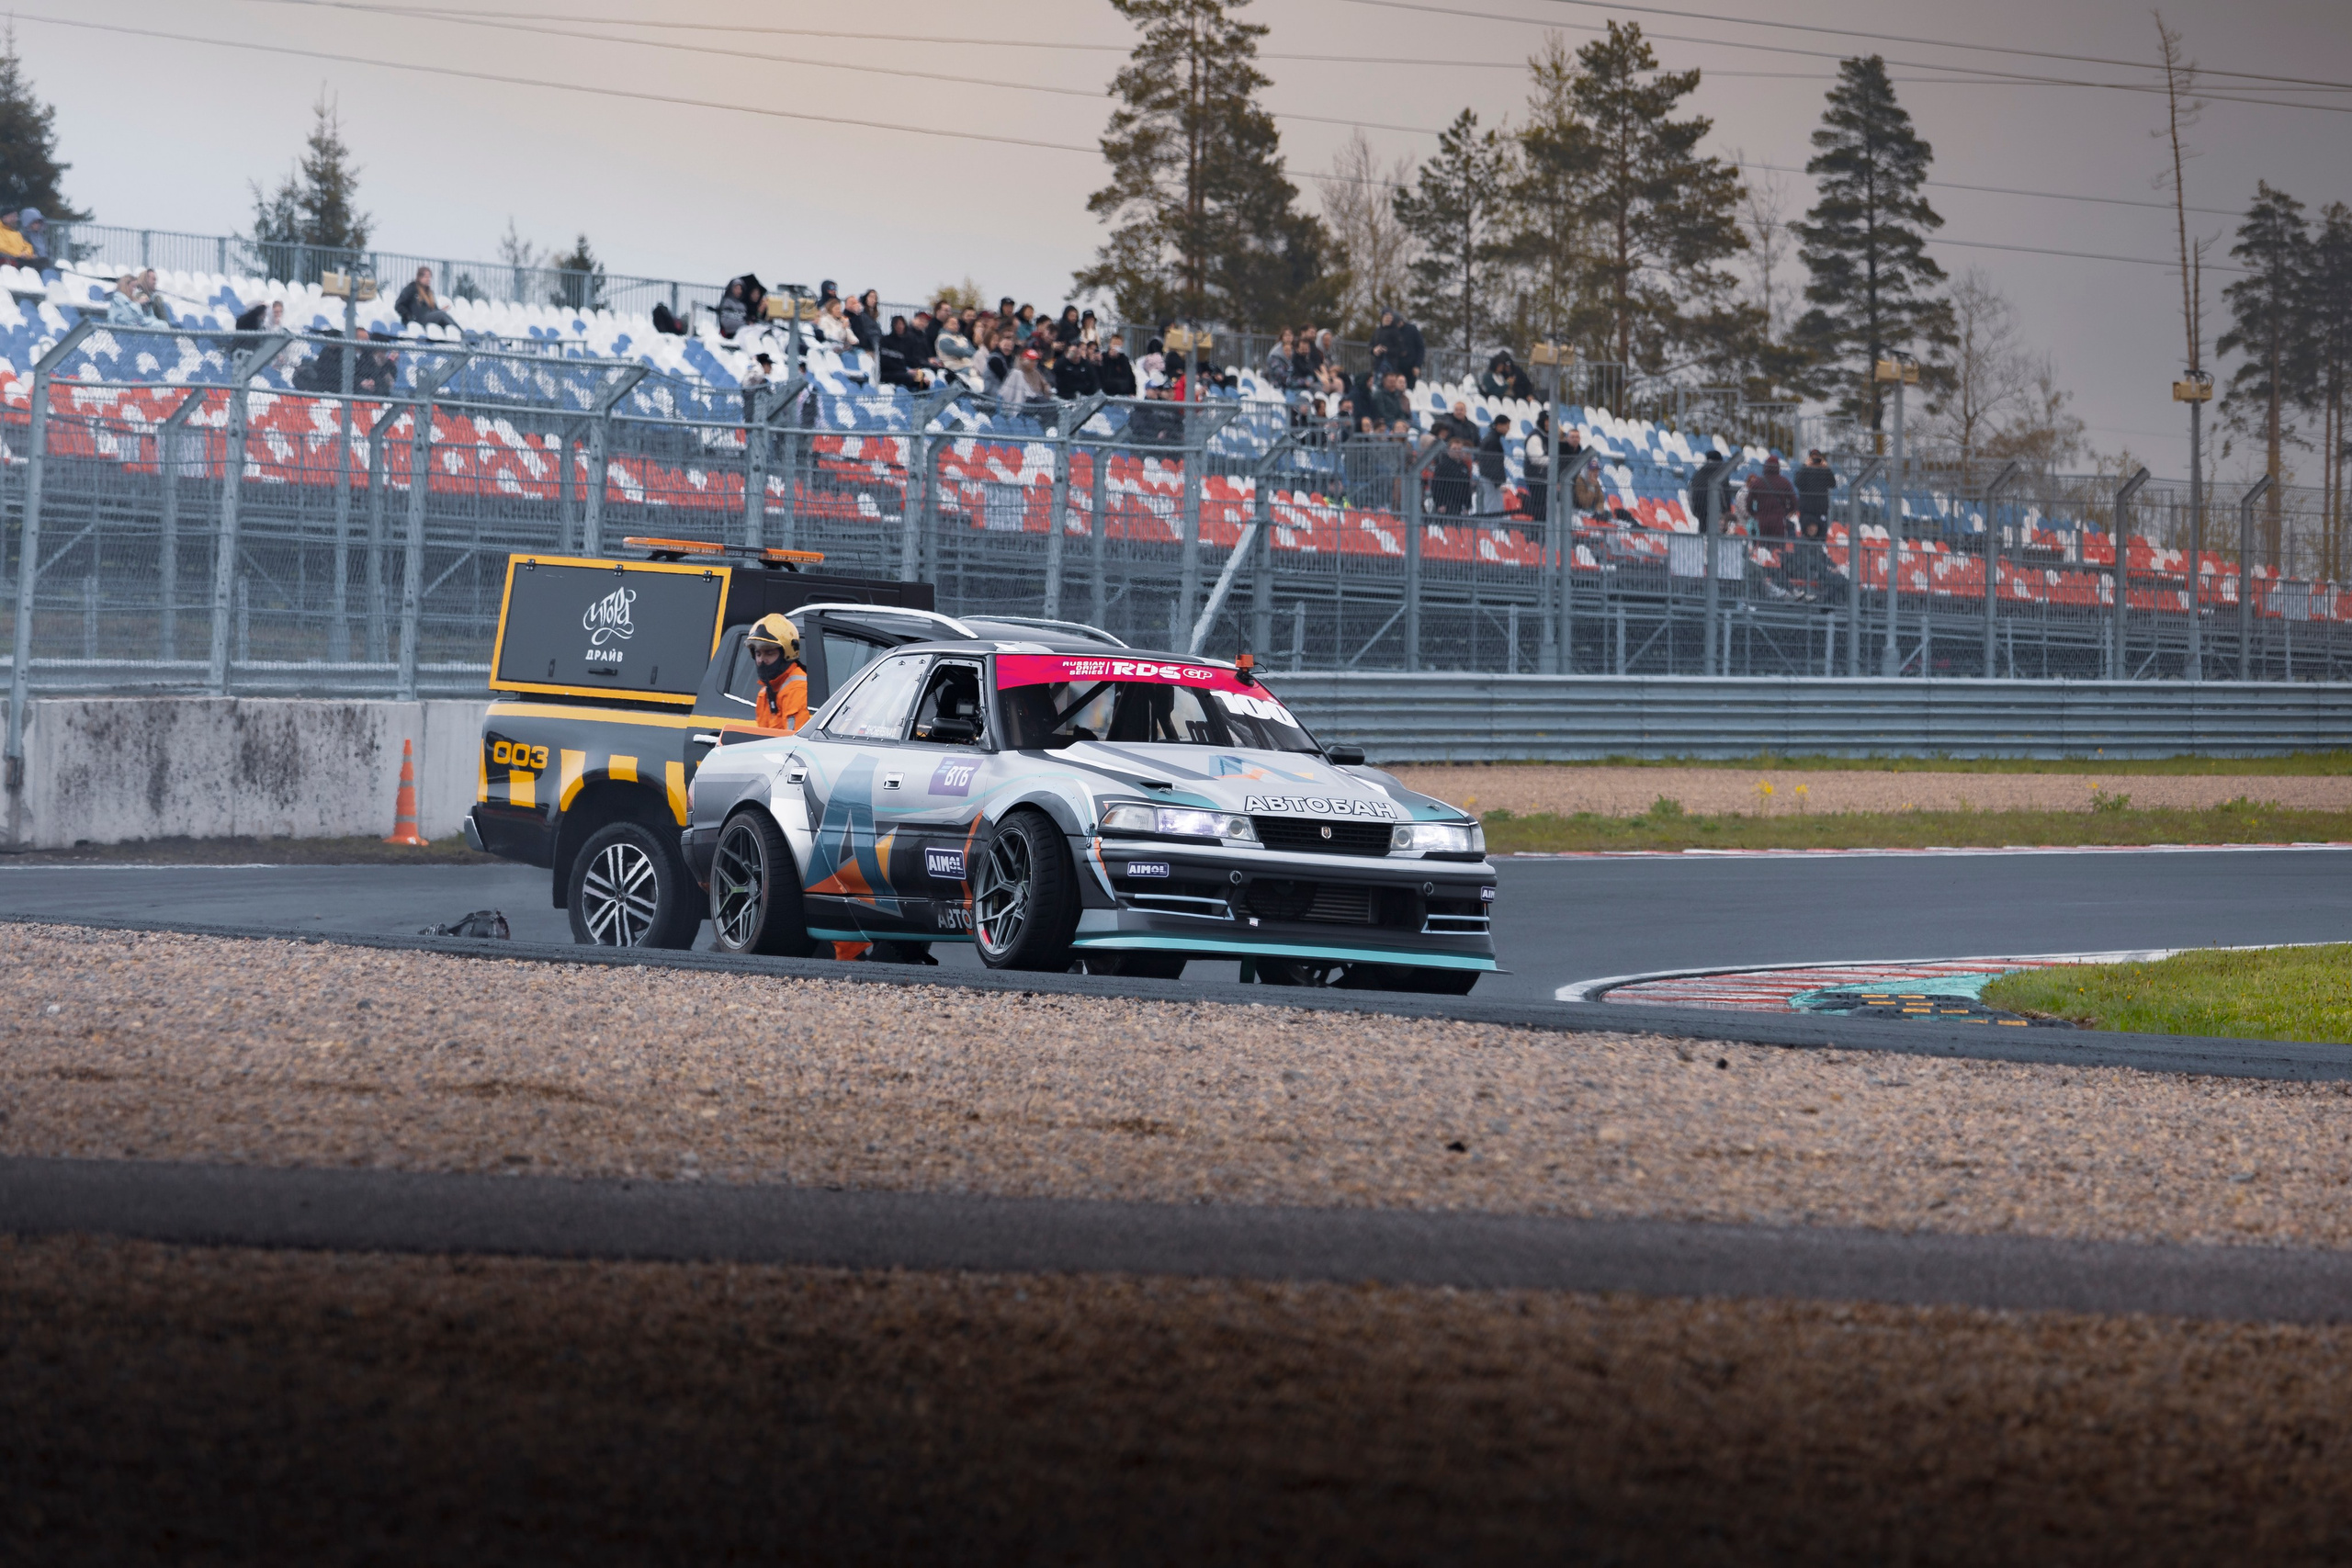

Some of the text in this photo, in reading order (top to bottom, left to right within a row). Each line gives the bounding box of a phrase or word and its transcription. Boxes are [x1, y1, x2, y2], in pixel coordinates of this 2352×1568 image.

[585, 649, 624, 662] ДРАЙВ
[1112, 661, 1213, 680] RDS GP
[1210, 690, 1299, 728] 100
[492, 740, 549, 770] 003
[944, 765, 975, 787] ВТБ
[1244, 795, 1398, 819] АВТОБАН
[928, 854, 964, 874] AIMOL
[1128, 864, 1167, 875] AIMOL
[937, 908, 973, 929] АВТО
